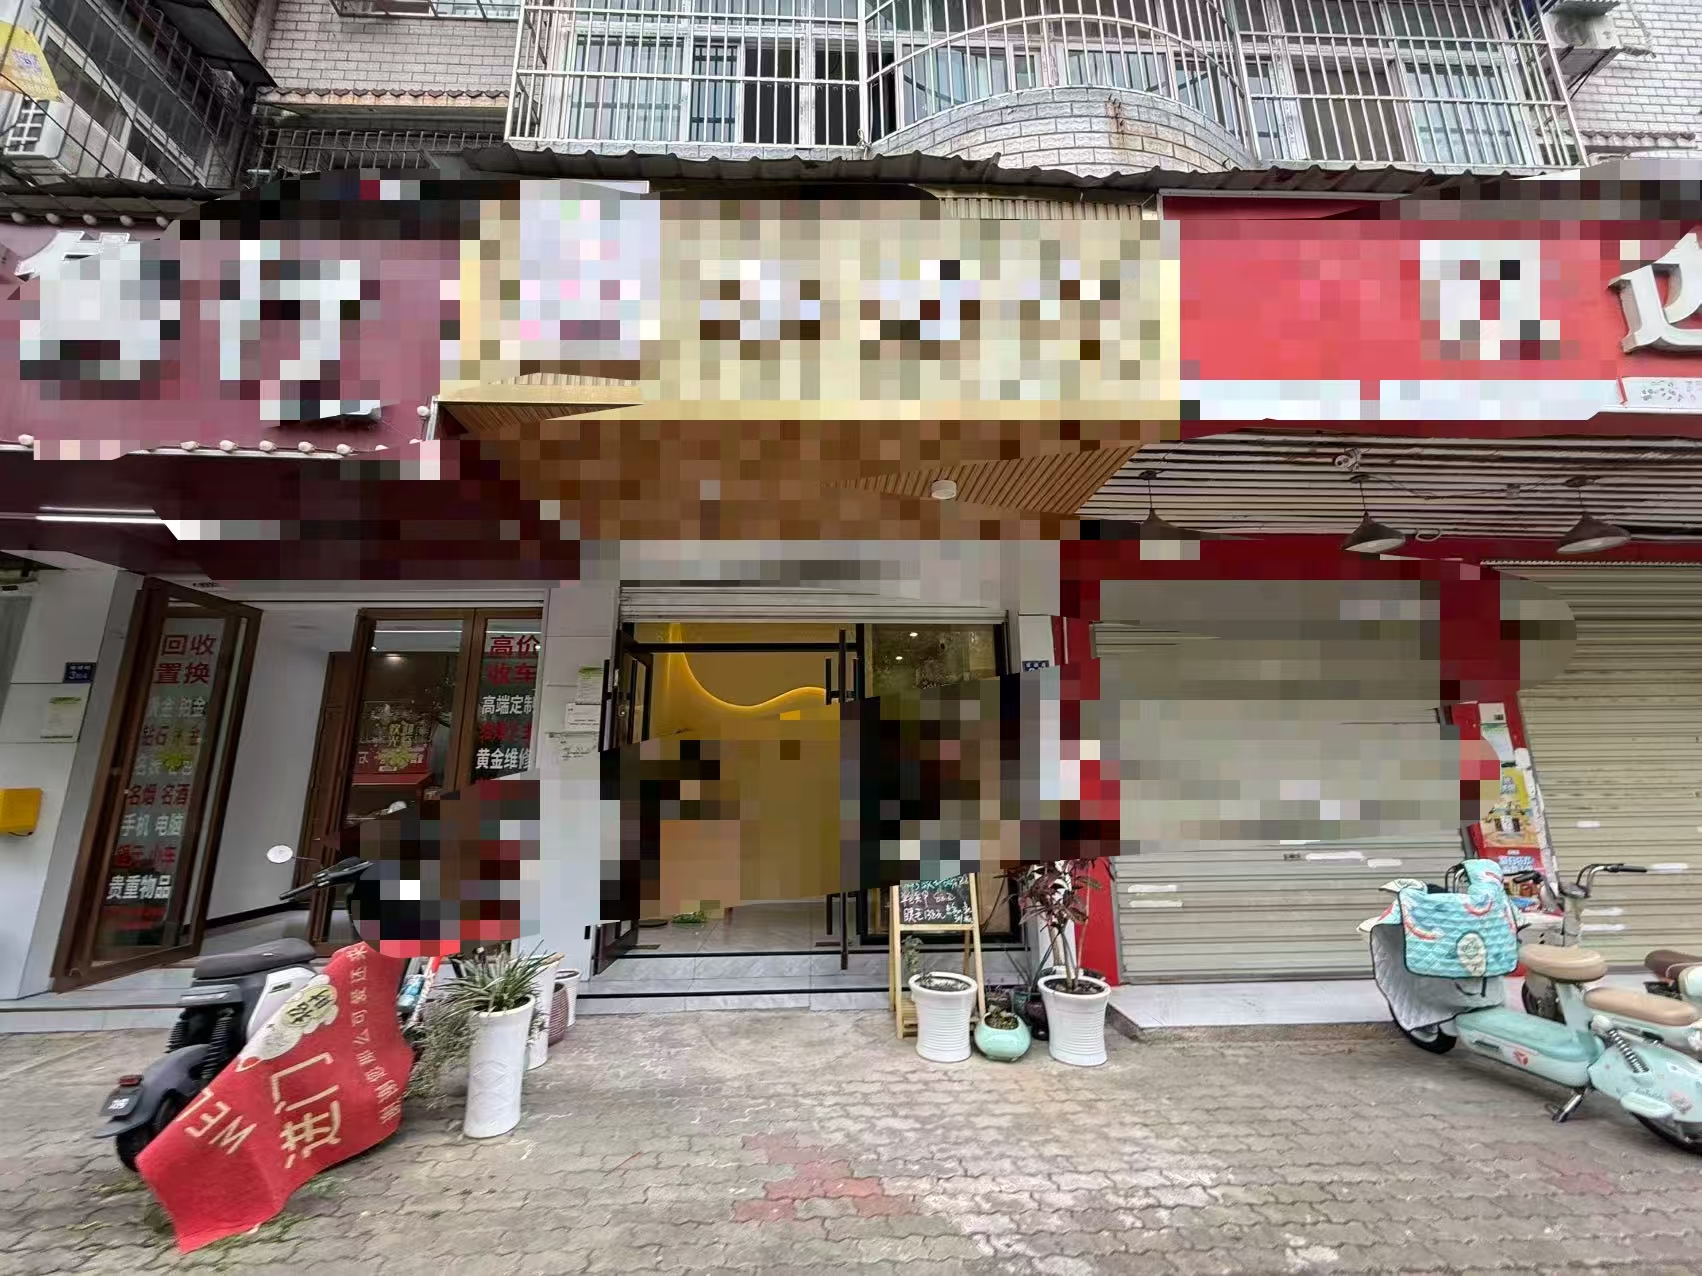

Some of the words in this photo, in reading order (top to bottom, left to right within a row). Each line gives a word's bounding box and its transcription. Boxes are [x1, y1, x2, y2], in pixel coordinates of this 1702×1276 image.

[160, 634, 217, 657] 回收
[489, 634, 541, 657] 高价
[153, 662, 210, 685] 置换
[480, 694, 537, 716] 高端定制
[476, 748, 532, 771] 黄金维修
[120, 813, 149, 838] 手机
[154, 812, 186, 837] 电脑
[106, 874, 173, 901] 贵重物品
[271, 1051, 342, 1169] 进门
